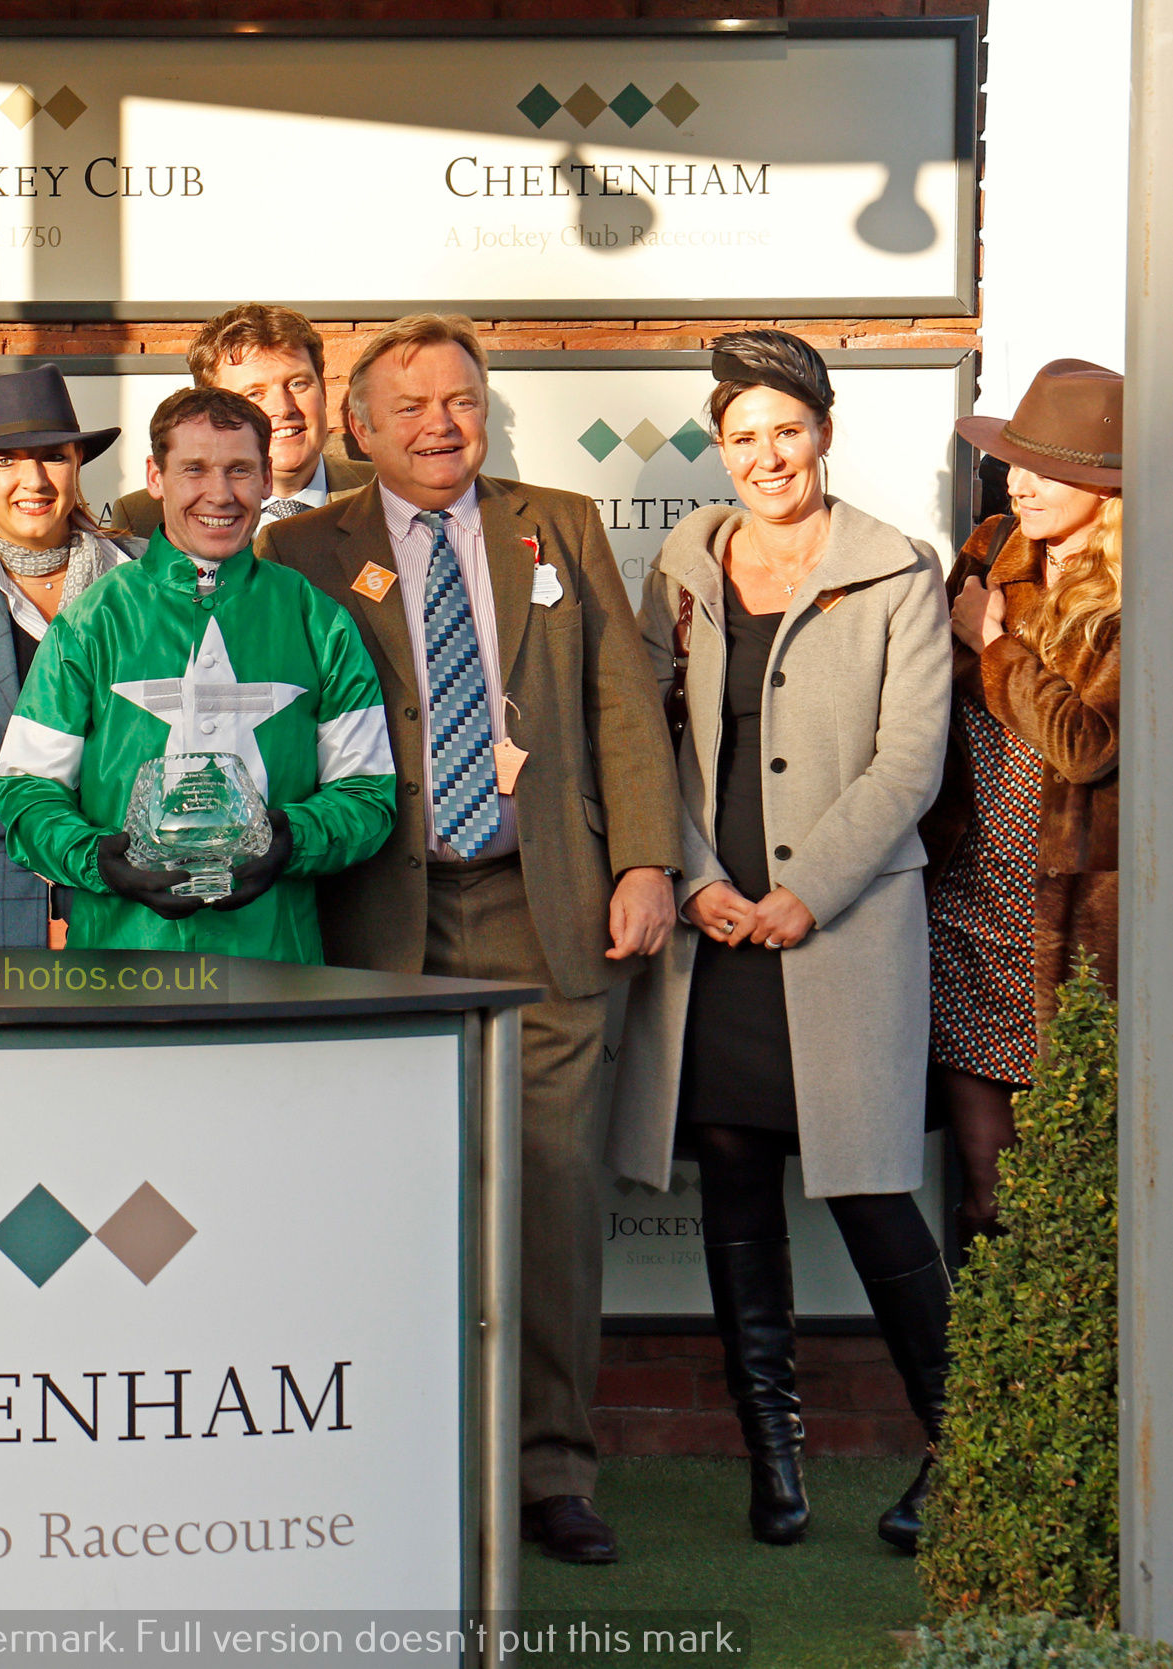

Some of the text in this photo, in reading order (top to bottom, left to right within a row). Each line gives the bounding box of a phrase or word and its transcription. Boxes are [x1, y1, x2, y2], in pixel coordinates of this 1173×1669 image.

[84, 156, 204, 198] CLUB
[444, 156, 771, 198] CHELTENHAM
[9, 226, 62, 248] 1750
[444, 224, 771, 254] A Jockey Club Racecourse
[607, 1212, 704, 1241] JOCKEY
[39, 1512, 355, 1560] Racecourse
